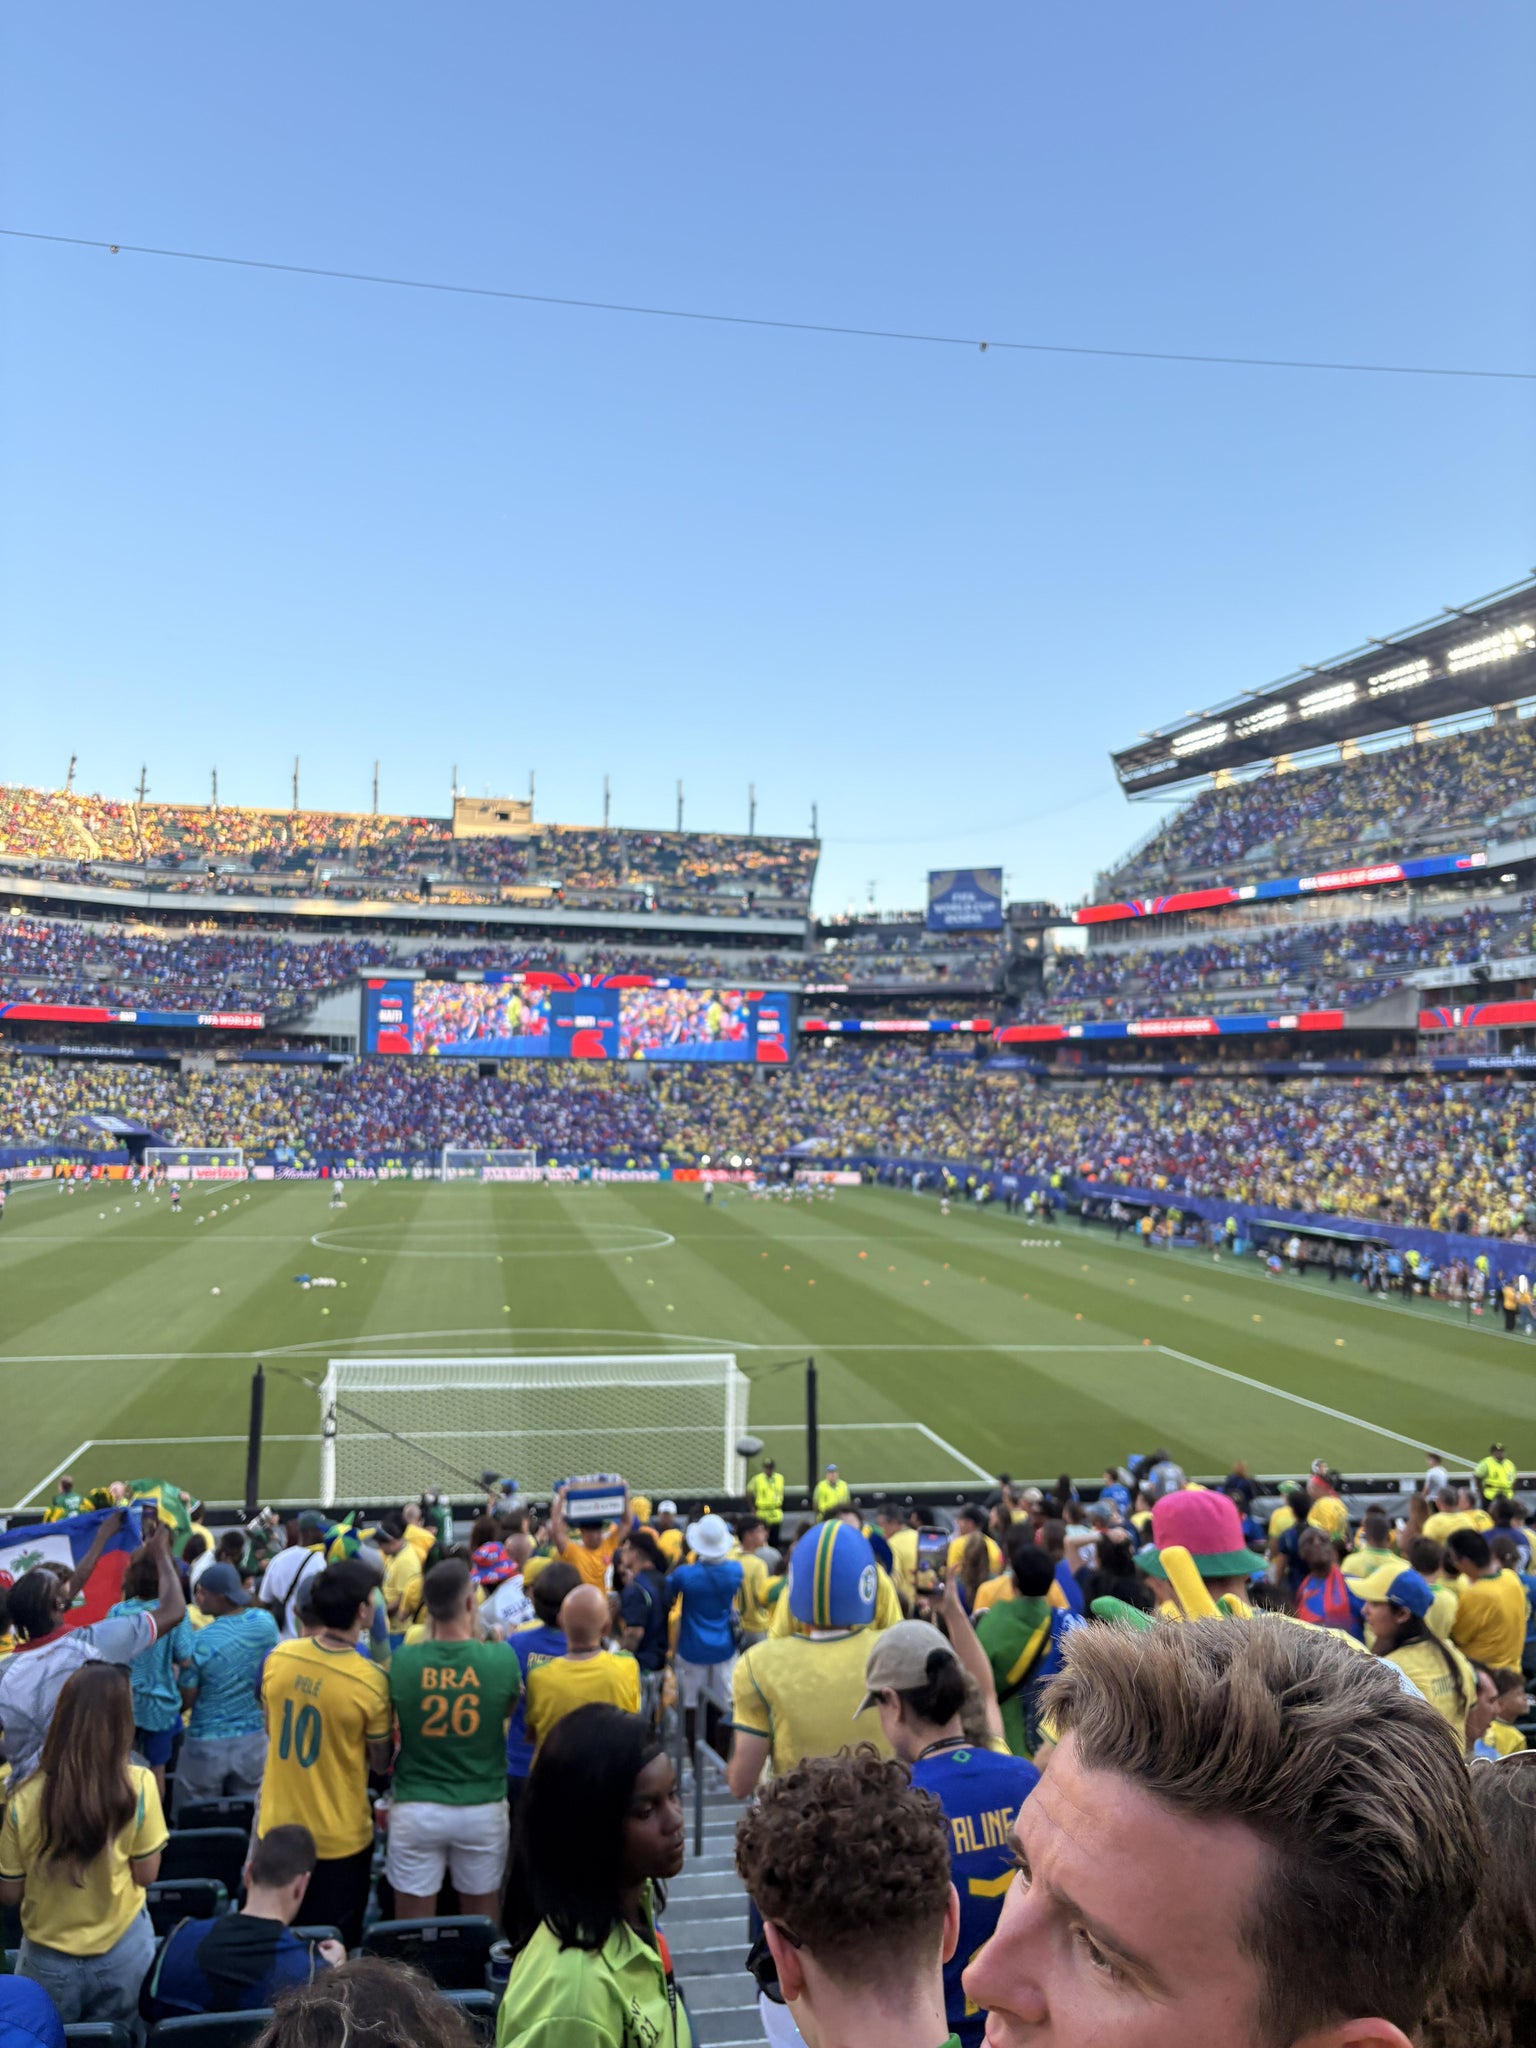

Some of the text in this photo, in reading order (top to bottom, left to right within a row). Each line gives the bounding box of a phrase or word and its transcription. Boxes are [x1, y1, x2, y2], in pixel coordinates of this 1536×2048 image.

[197, 1014, 219, 1026] FIFA
[220, 1015, 252, 1027] WORLD
[331, 1166, 377, 1180] ULTRA
[592, 1168, 661, 1182] Hisense
[421, 1666, 480, 1690] BRA
[420, 1693, 480, 1737] 26
[279, 1698, 322, 1769] 10
